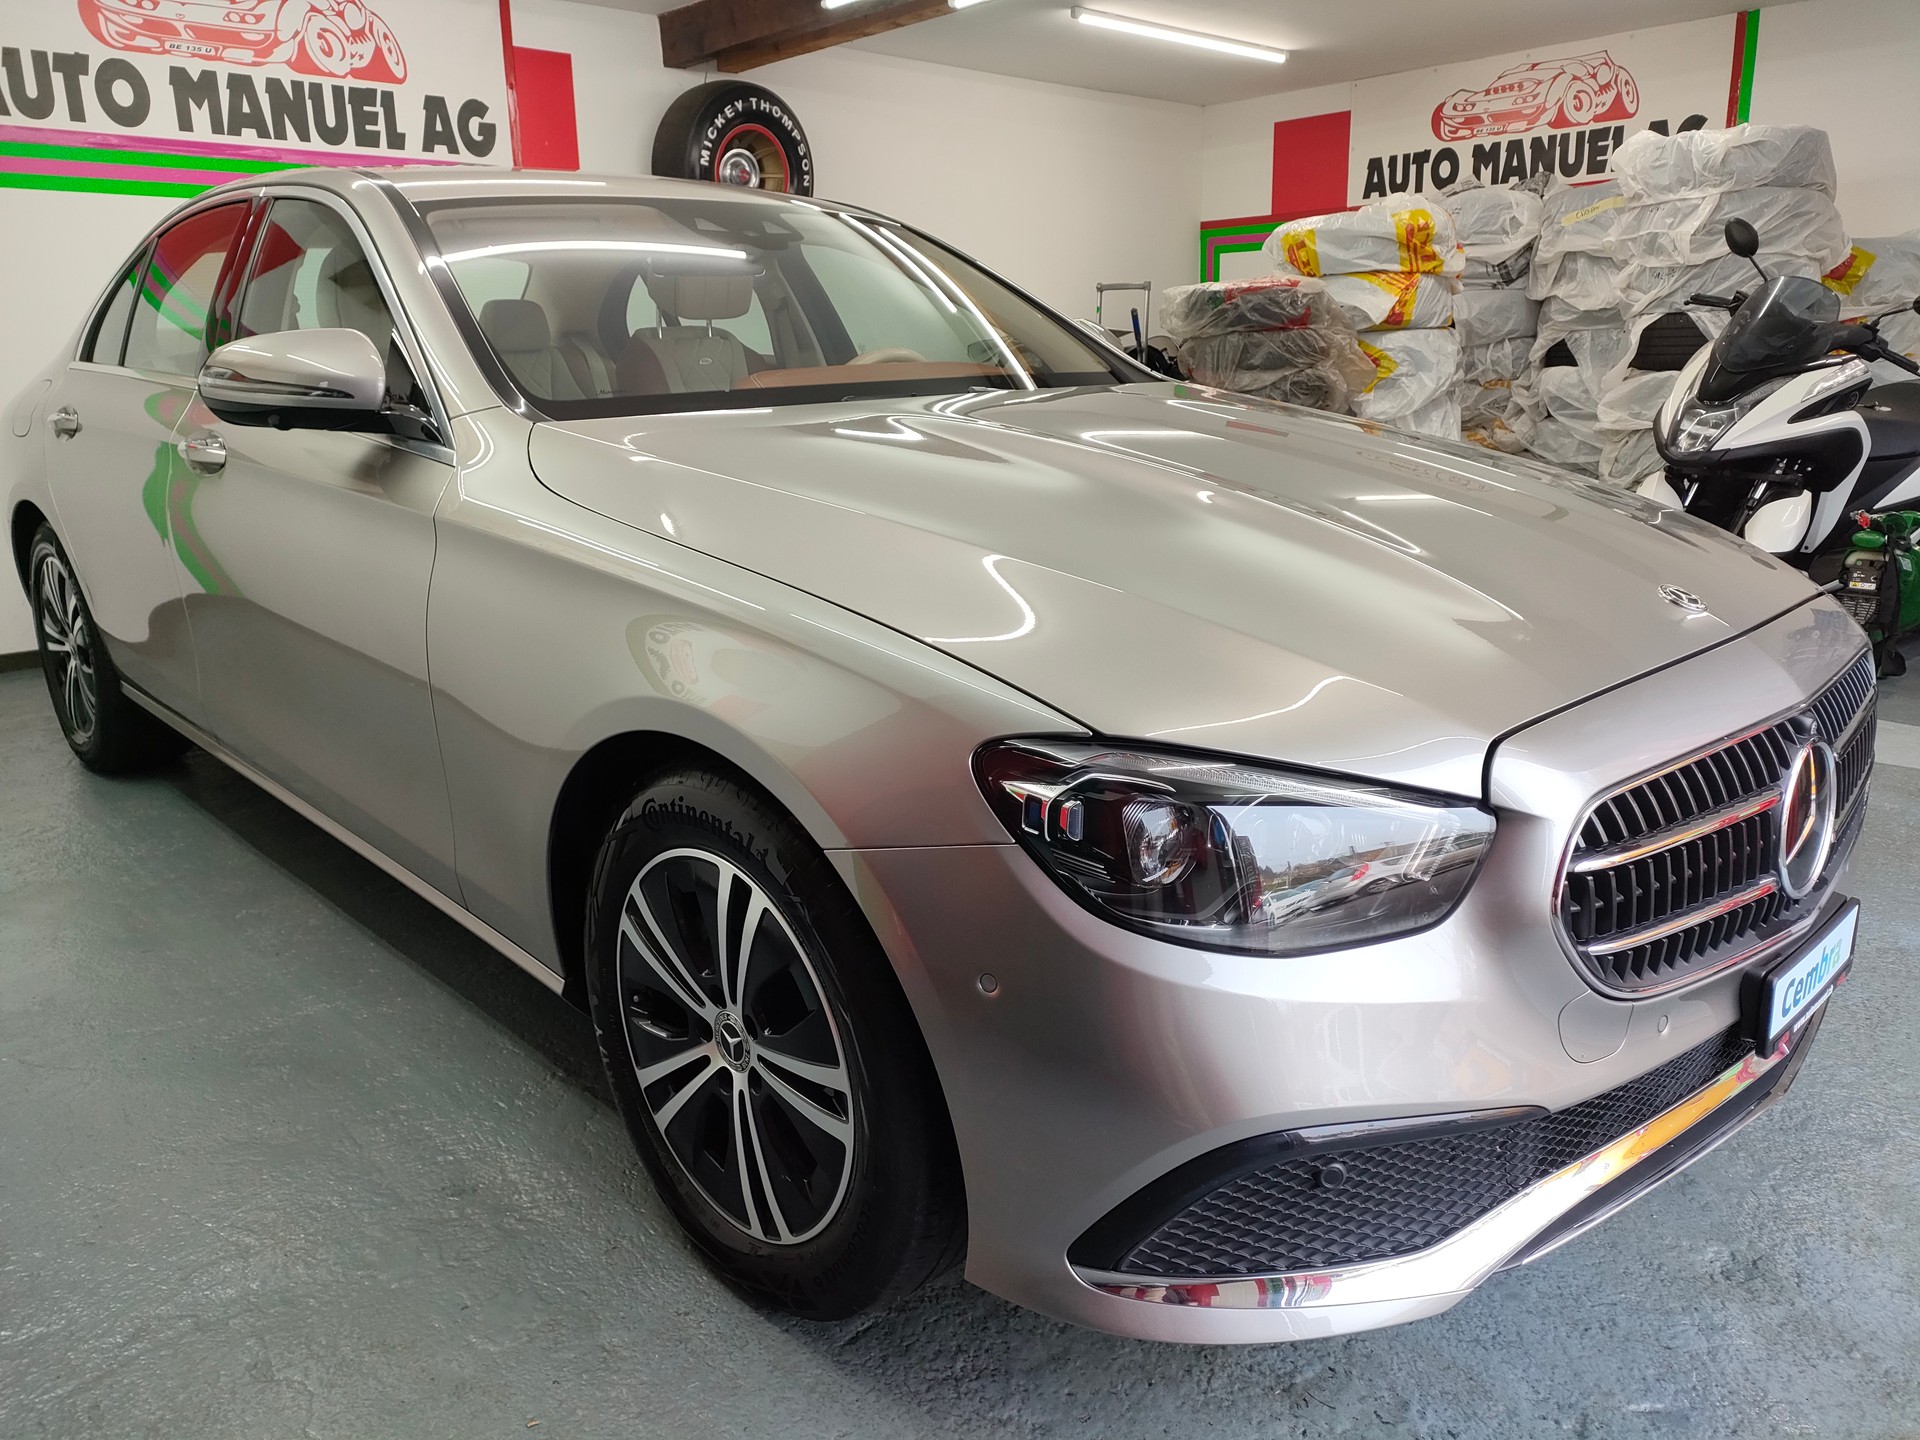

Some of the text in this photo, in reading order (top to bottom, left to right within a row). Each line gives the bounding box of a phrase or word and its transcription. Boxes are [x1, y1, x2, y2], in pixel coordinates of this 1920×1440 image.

[0, 46, 497, 157] UTO MANUEL AG
[700, 97, 810, 187] MICKEY THOMPSON
[1362, 147, 1460, 200] AUTO
[641, 795, 755, 857] Continental
[1781, 938, 1843, 1018] Cembra
